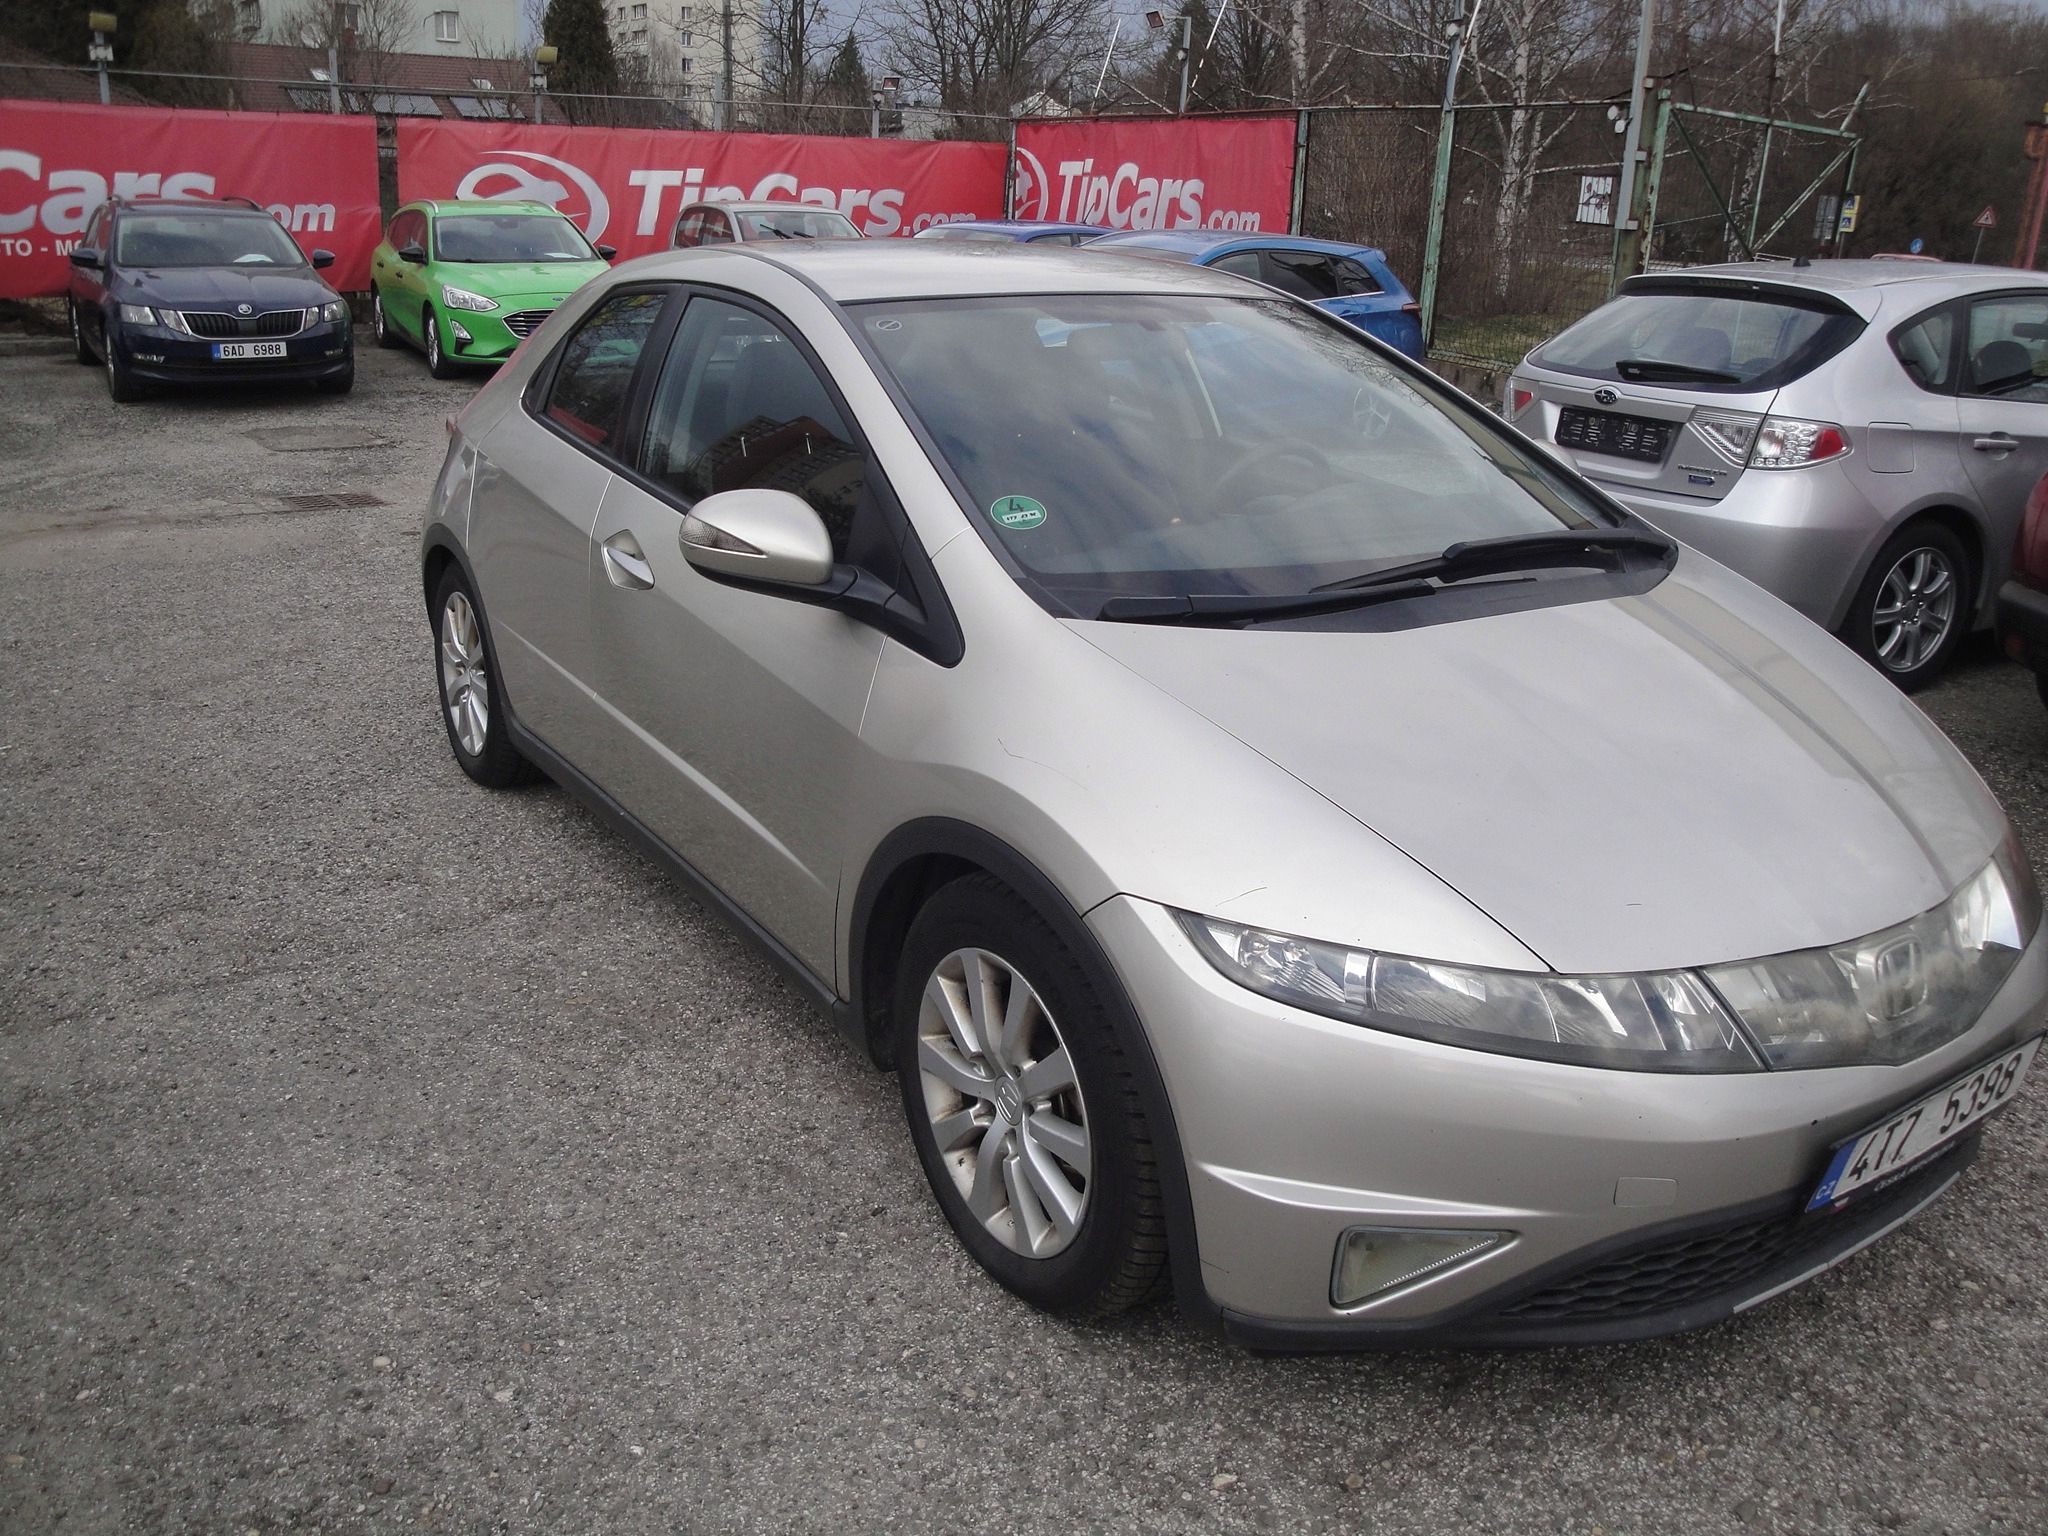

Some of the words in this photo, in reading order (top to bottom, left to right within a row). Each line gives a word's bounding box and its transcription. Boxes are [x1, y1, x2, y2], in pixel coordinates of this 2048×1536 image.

[223, 345, 245, 357] 6AD
[253, 344, 281, 356] 6988
[1848, 1107, 1924, 1181] 4T7
[1939, 1052, 2023, 1135] 5398
[1815, 1180, 1836, 1200] CZ
